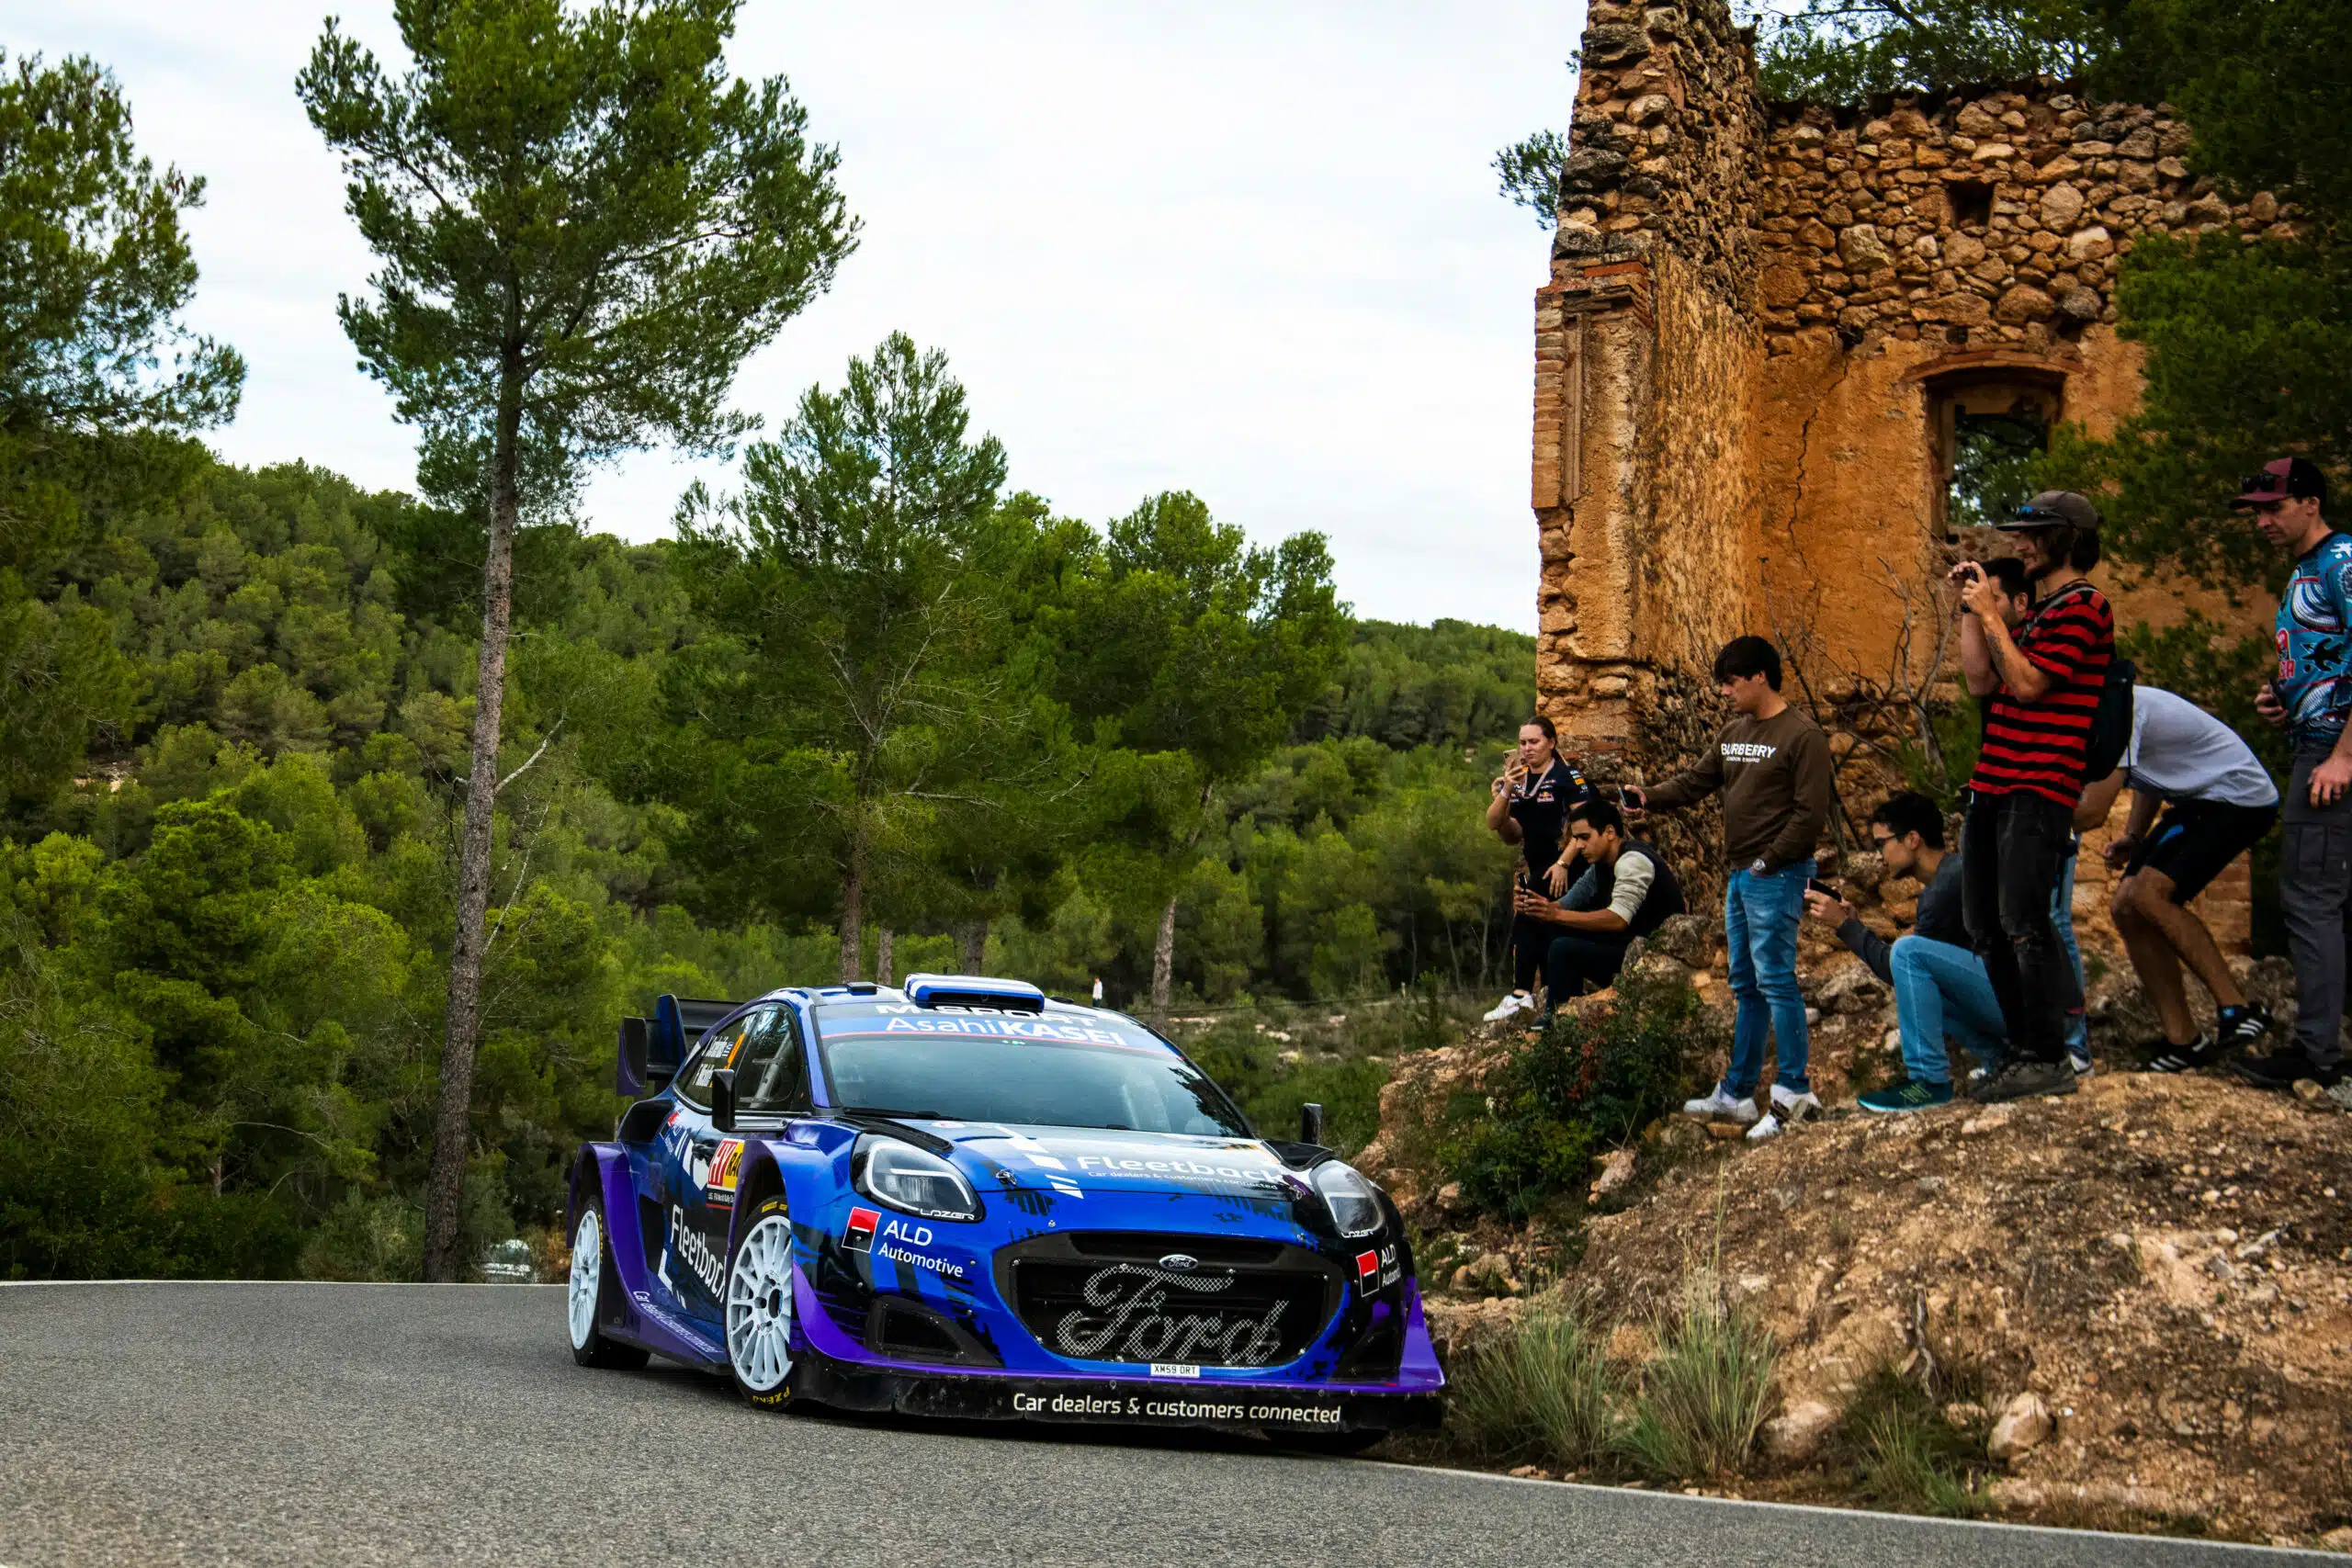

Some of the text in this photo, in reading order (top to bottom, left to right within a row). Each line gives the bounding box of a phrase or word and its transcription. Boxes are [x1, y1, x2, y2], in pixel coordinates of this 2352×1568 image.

[1721, 743, 1777, 759] BURBERRY
[1077, 1156, 1288, 1185] Fleetback
[920, 1208, 974, 1220] LAZER
[883, 1220, 933, 1247] ALD
[670, 1203, 727, 1303] Fleetback
[878, 1242, 964, 1278] Automotive
[1169, 1258, 1192, 1268] Ford
[1381, 1244, 1396, 1269] ALD
[1057, 1265, 1289, 1365] Ford
[1154, 1365, 1177, 1374] XM59
[1013, 1393, 1341, 1423] Car dealers & customers connected
